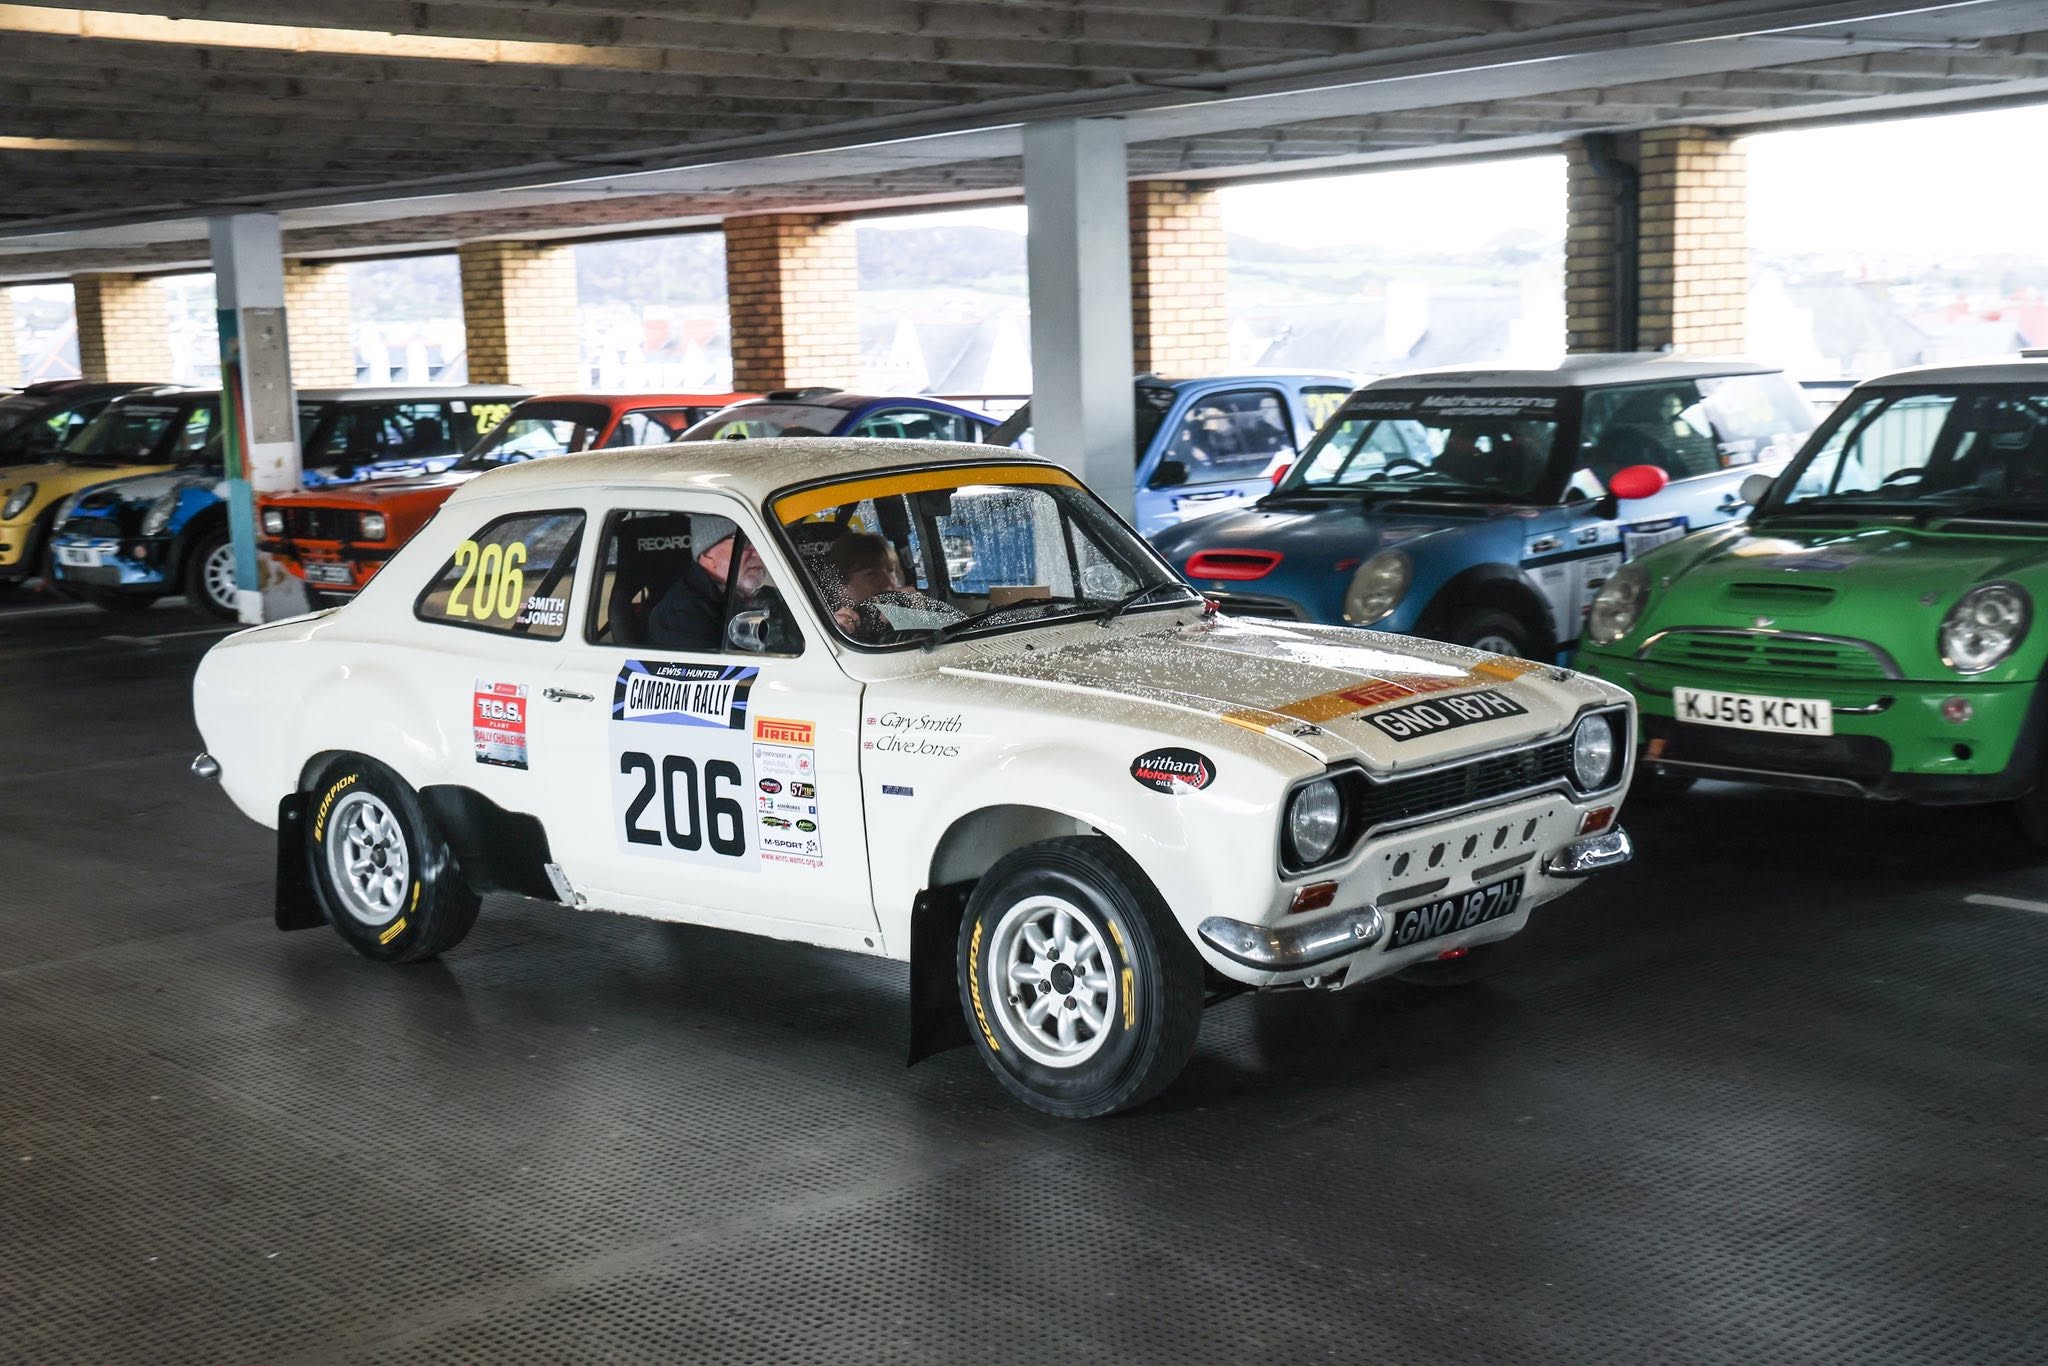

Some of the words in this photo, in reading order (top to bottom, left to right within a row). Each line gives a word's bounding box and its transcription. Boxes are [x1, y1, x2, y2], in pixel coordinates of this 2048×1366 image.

[1421, 395, 1558, 408] Mathewsons
[638, 535, 692, 551] RECARO
[446, 539, 527, 620] 206
[527, 597, 566, 612] SMITH
[525, 611, 564, 626] JONES
[630, 678, 692, 711] CAMBRIAN
[692, 684, 731, 716] RALLY
[880, 711, 918, 733] Gary
[915, 714, 962, 733] Smith
[1373, 705, 1450, 736] GNO
[1444, 692, 1518, 721] 187H
[1684, 692, 1754, 725] KJ56
[1761, 699, 1819, 730] KCN
[474, 730, 493, 742] RALLY
[489, 721, 510, 729] PLANT
[757, 720, 811, 743] PIRELLI
[876, 733, 915, 754] Clive
[913, 739, 960, 757] Jones
[1140, 756, 1200, 773] witham
[620, 751, 746, 857] 206
[764, 838, 803, 849] M-SPORT
[1398, 901, 1455, 945] GNO
[1456, 879, 1519, 929] 187H
